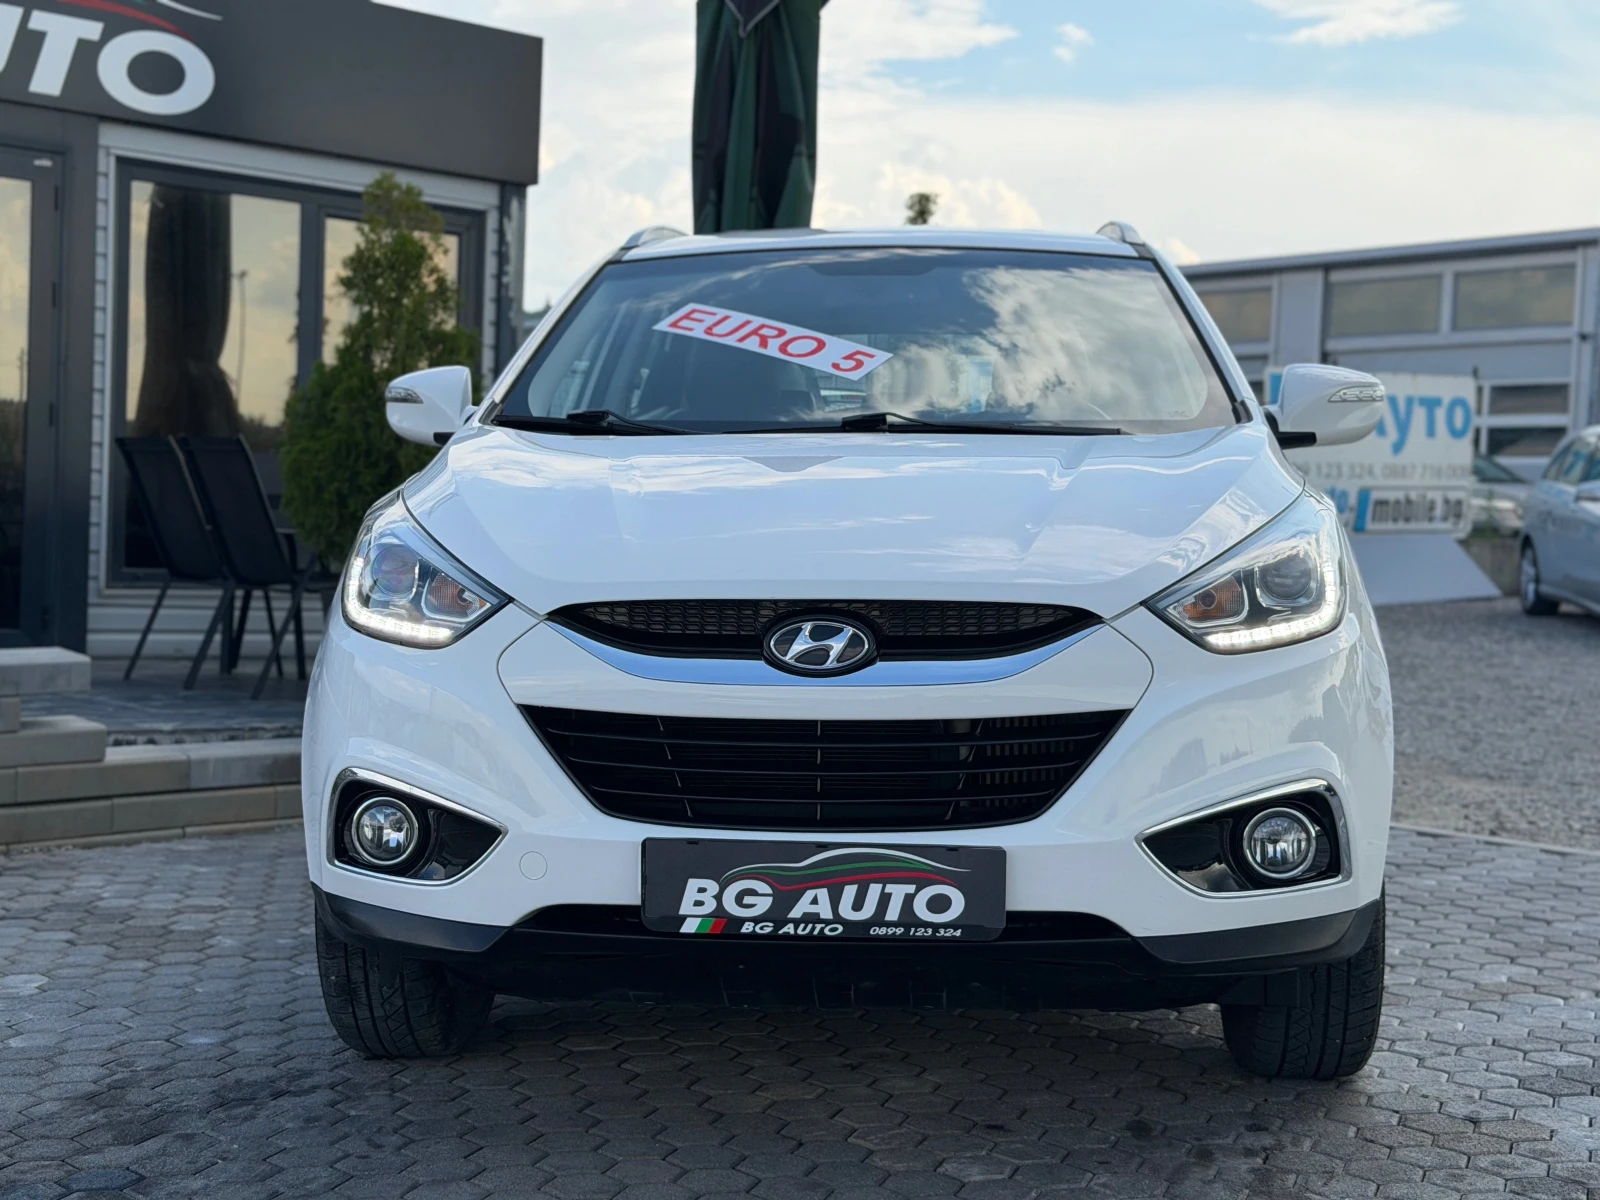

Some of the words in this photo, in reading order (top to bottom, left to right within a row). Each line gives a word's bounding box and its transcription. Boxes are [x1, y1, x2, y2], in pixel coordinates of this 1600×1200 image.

[0, 3, 215, 116] TO
[667, 308, 826, 358] EURO
[831, 349, 876, 373] 5
[1375, 394, 1472, 456] уто
[1371, 492, 1463, 528] mobile.bg
[678, 877, 774, 917] BG
[787, 883, 966, 923] AUTO
[740, 921, 774, 934] BG
[777, 923, 844, 936] AUTO
[869, 926, 904, 936] 0899
[909, 927, 933, 937] 123
[935, 927, 962, 937] 324
